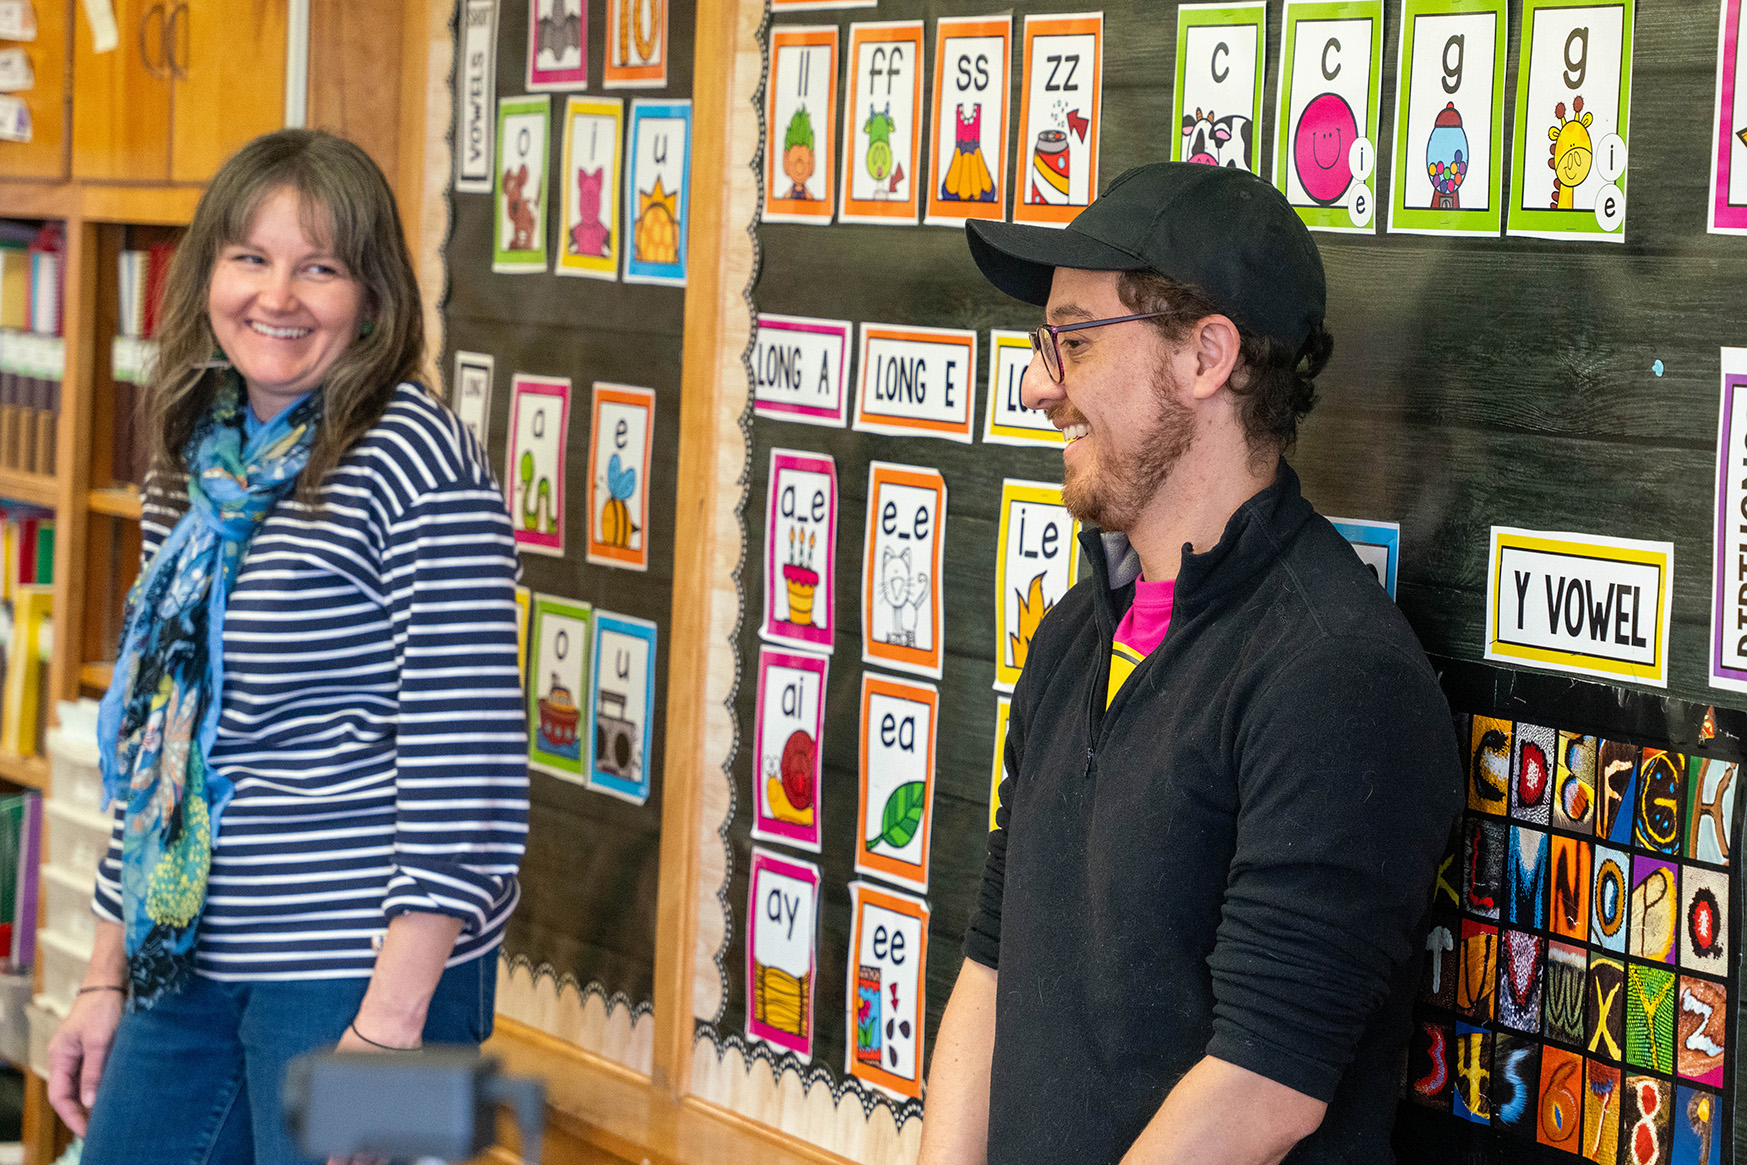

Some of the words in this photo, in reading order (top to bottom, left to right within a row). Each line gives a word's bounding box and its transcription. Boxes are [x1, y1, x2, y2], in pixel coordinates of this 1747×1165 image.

[869, 46, 903, 95] ff
[956, 54, 990, 92] ss
[1044, 54, 1080, 92] zz
[1210, 41, 1230, 84] c
[1321, 37, 1342, 82] c
[1441, 33, 1465, 95] g
[1563, 26, 1589, 90] g
[518, 128, 530, 158] o
[653, 133, 668, 164] u
[1359, 146, 1365, 172] i
[1608, 144, 1615, 171] i
[1355, 194, 1366, 215] e
[1604, 196, 1616, 218] e
[758, 343, 802, 391] LONG
[817, 349, 830, 395] A
[876, 354, 926, 404] LONG
[945, 361, 956, 408] E
[533, 408, 545, 440] a
[615, 418, 629, 449] e
[1514, 570, 1531, 630] Y
[1545, 574, 1647, 649] VOWEL
[555, 630, 568, 661] o
[616, 647, 631, 680] u
[781, 677, 804, 720] ai
[880, 712, 916, 753] ea
[767, 887, 800, 941] ay
[873, 925, 906, 966] ee
